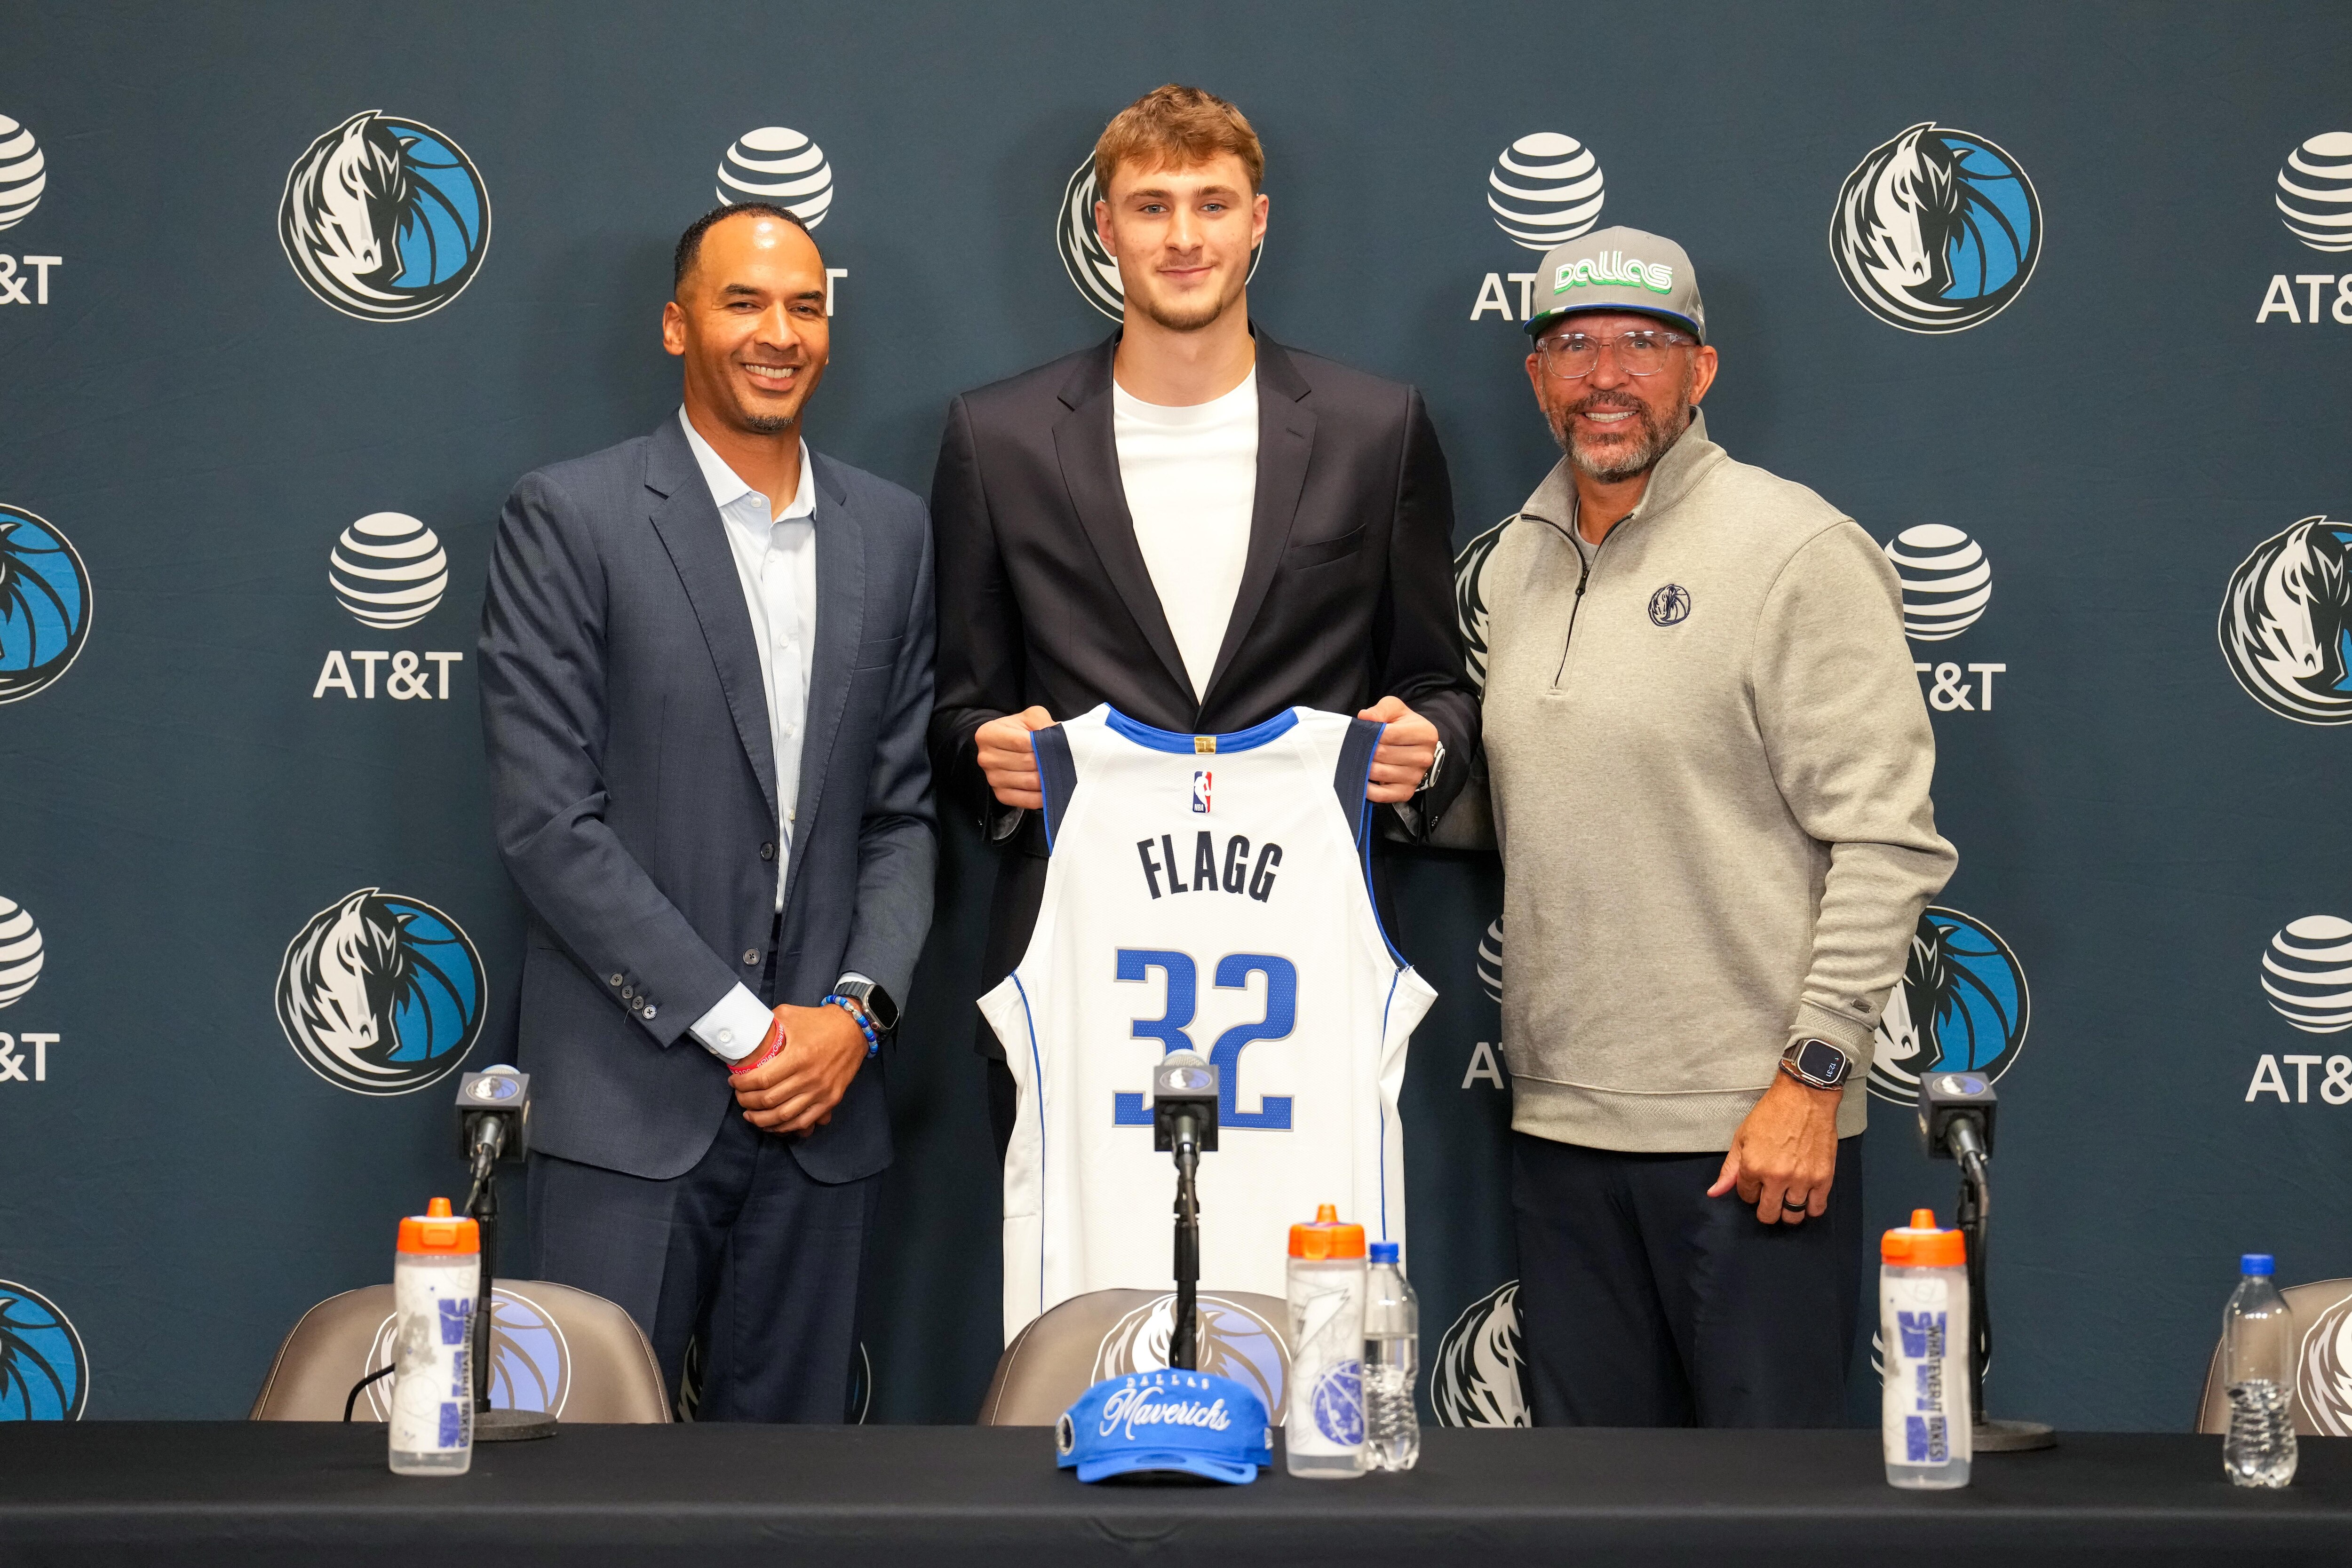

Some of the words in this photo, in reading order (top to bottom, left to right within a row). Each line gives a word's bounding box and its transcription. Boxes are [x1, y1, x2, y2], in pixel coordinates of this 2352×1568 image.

[0, 253, 62, 304] &T
[1470, 272, 1537, 321] AT
[2256, 274, 2352, 324] AT
[313, 650, 462, 699] AT&T
[1914, 662, 2006, 711] &T
[1136, 830, 1283, 903] FLAGG
[0, 1032, 60, 1081] &T
[1112, 945, 1299, 1132] 32
[1826, 1063, 1836, 1077] 12:31
[2245, 1054, 2352, 1105] AT&
[1126, 1374, 1210, 1390] DALLAS
[1099, 1386, 1232, 1441] Mavericks
